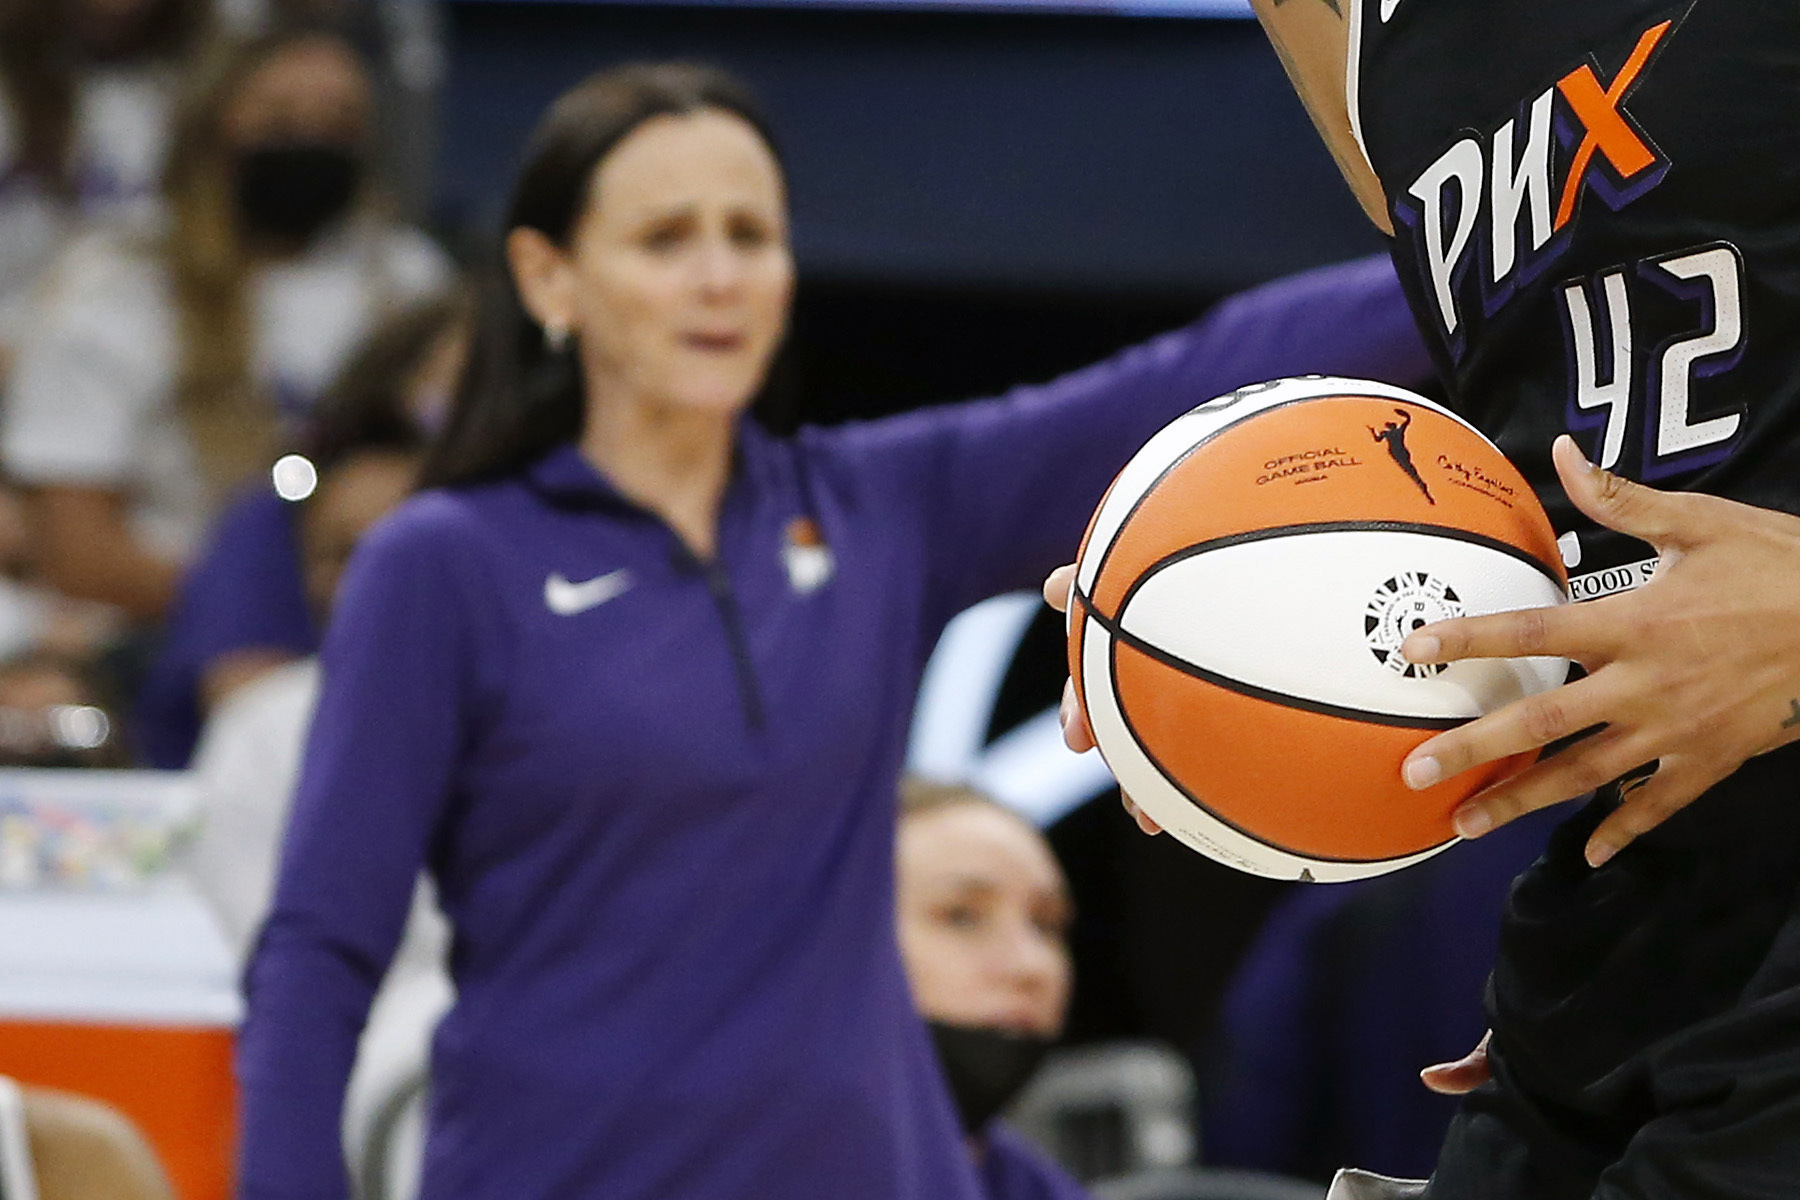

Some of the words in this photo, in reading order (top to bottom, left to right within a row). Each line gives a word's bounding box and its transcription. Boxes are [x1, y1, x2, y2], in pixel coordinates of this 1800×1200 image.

[1563, 248, 1742, 471] 42
[1256, 465, 1310, 485] GAME
[1314, 457, 1362, 471] BALL
[1264, 447, 1346, 470] OFFICIAL
[1568, 567, 1633, 599] FOOD
